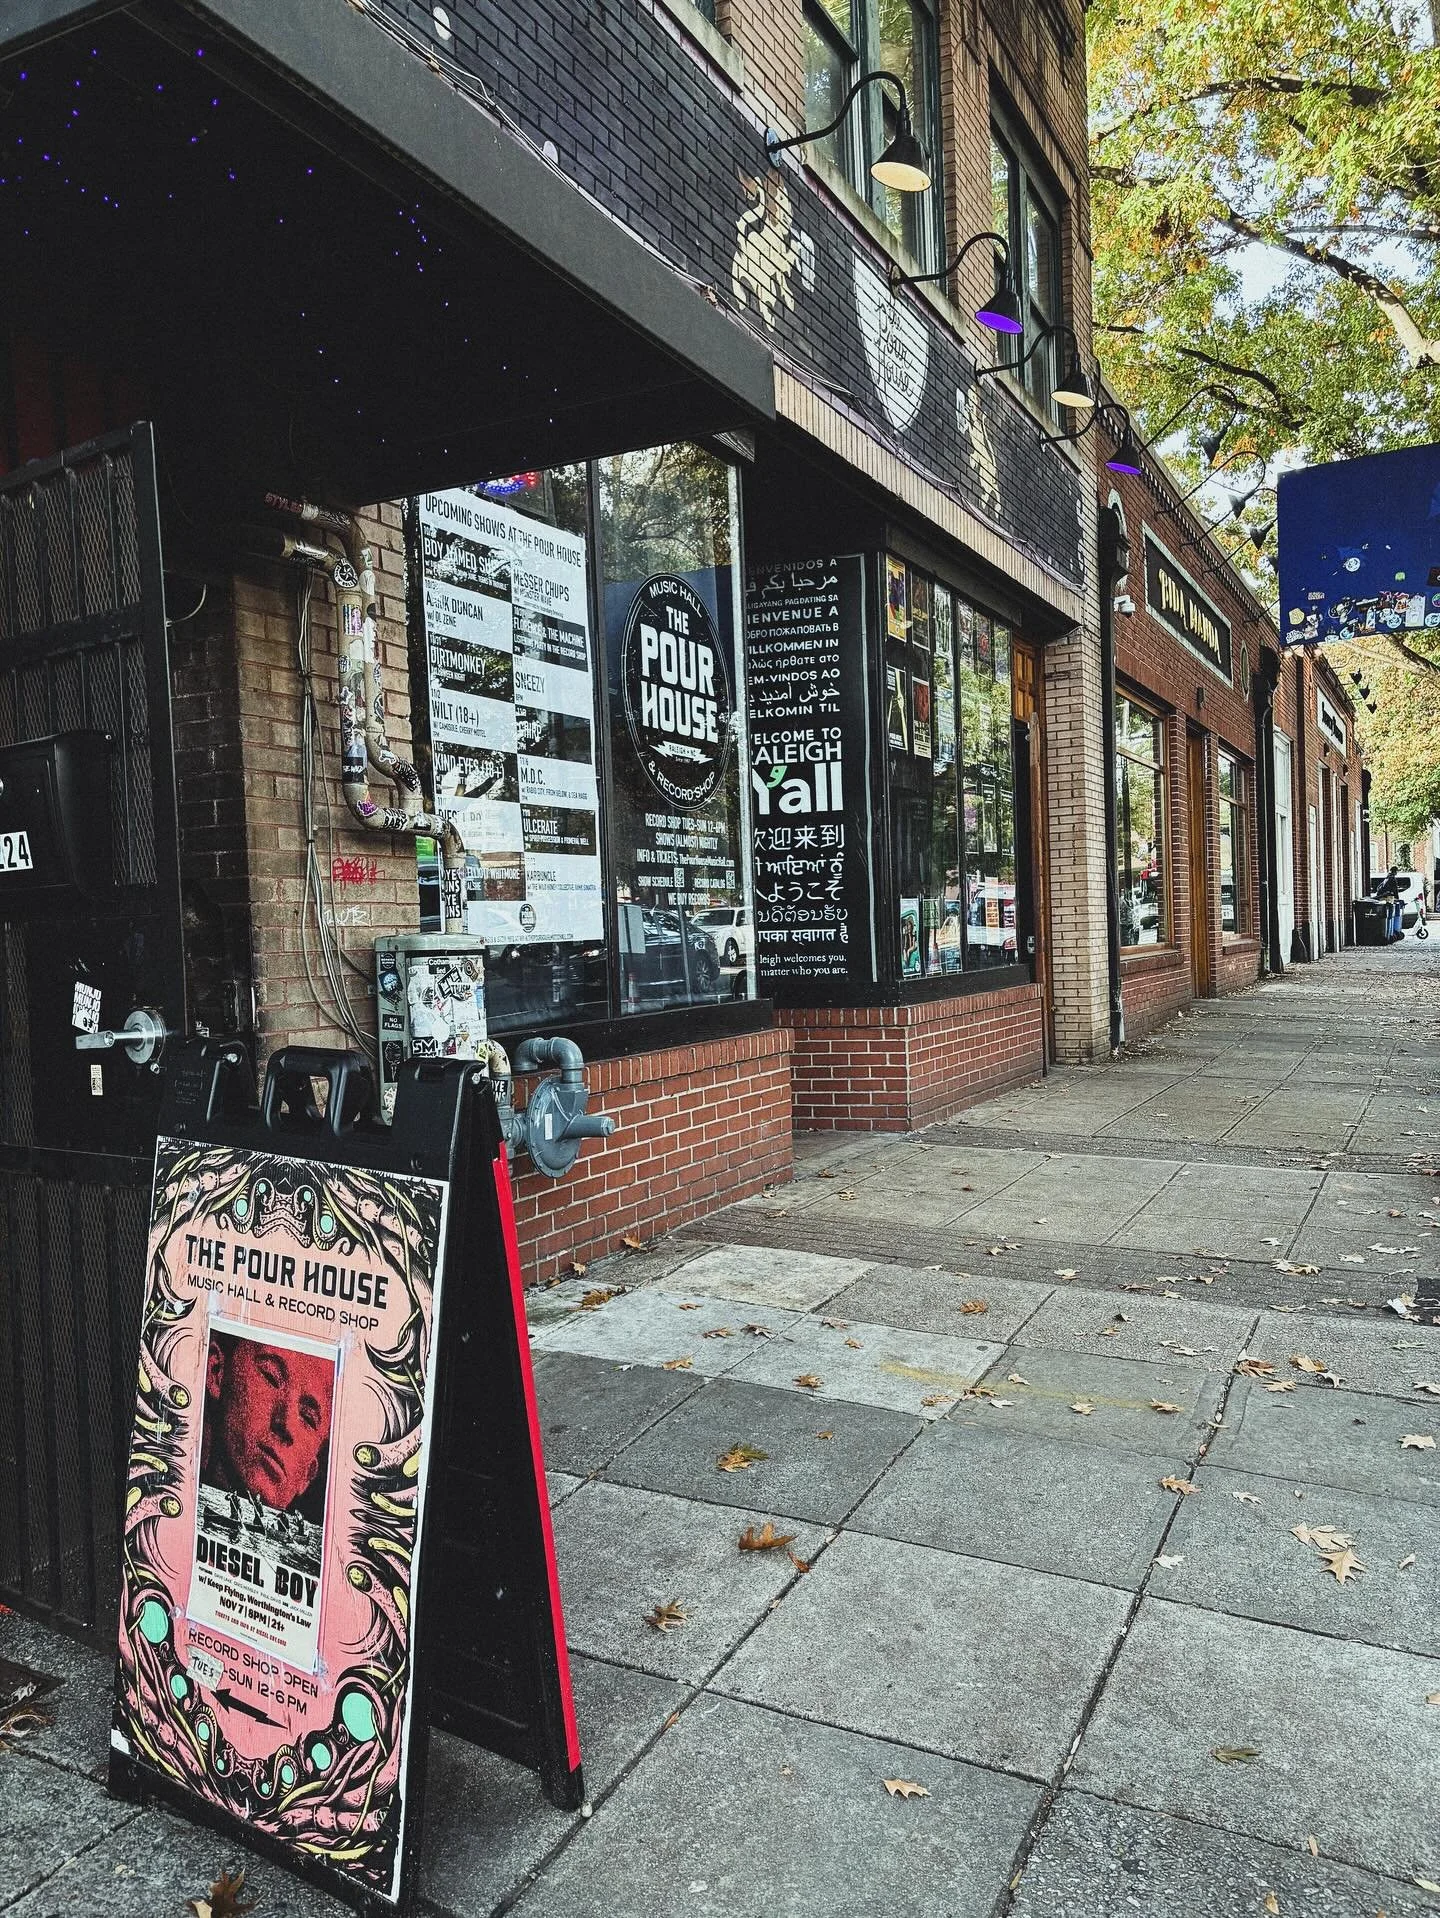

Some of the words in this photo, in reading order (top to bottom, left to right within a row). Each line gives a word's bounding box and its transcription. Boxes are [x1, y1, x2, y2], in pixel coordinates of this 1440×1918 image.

[425, 493, 472, 527] UPCOMING
[474, 513, 506, 539] SHOWS
[508, 526, 517, 542] AT
[518, 530, 532, 548] THE
[534, 536, 555, 559] POUR
[556, 544, 582, 568] HOUSE
[425, 538, 444, 560] BOY
[830, 558, 838, 567] A
[545, 579, 570, 602] CHUPS
[649, 581, 678, 599] MUSIC
[679, 588, 702, 618] HALL
[746, 600, 783, 609] LIGAYANG
[784, 595, 826, 606] PAGDATING
[828, 594, 838, 602] SA
[451, 598, 484, 621] DUNCAN
[666, 605, 690, 636] THE
[747, 607, 822, 625] IENVENUE
[828, 605, 839, 617] A
[747, 629, 767, 640] ОБРО
[747, 640, 822, 655] ILLKOMMEN
[825, 638, 839, 648] IN
[430, 645, 486, 676] DIRTMONKEY
[640, 622, 715, 697] POUR
[515, 671, 545, 693] SNEEZY
[748, 670, 817, 686] EM-VINDOS
[821, 668, 840, 679] AO
[432, 700, 453, 721] WILT
[456, 705, 479, 727] (18+)
[640, 680, 719, 744] HOUSE
[749, 705, 813, 719] ELKOMIN
[819, 703, 840, 712] TIL
[750, 729, 814, 745] ELCOME
[821, 727, 841, 740] TO
[751, 740, 841, 766] ALEIGH
[520, 767, 546, 785] M.D.C.
[648, 760, 656, 775] &
[656, 771, 694, 801] RECORD
[694, 771, 715, 799] SHOP
[523, 818, 558, 835] ULCERATE
[645, 813, 666, 828] RECORD
[667, 815, 681, 829] SHOP
[0, 834, 30, 869] 24
[636, 848, 650, 863] INFO
[651, 851, 656, 863] &
[756, 880, 844, 902] ようこそ
[759, 954, 781, 967] leigh
[784, 953, 826, 963] welcomes
[760, 968, 790, 976] matter
[791, 966, 812, 975] who
[813, 967, 830, 977] you
[185, 1233, 226, 1272] THE
[232, 1245, 296, 1288] POUR
[304, 1260, 389, 1310] HOUSE
[187, 1273, 224, 1294] MUSIC
[227, 1283, 261, 1304] HALL
[265, 1294, 275, 1308] &
[278, 1296, 336, 1322] RECORD
[339, 1310, 379, 1332] SHOP
[196, 1534, 265, 1588] DIESEL
[274, 1565, 319, 1609] BOY
[198, 1574, 206, 1584] w/
[207, 1576, 224, 1592] Keep
[224, 1584, 246, 1602] Flying,
[247, 1594, 296, 1622] Worthington's
[296, 1615, 312, 1629] Law
[219, 1596, 238, 1612] NOV
[239, 1604, 244, 1615] 7
[248, 1609, 267, 1625] 8PM
[270, 1618, 285, 1633] 21+
[188, 1627, 239, 1661] RECORD
[242, 1653, 279, 1676] SHOP
[283, 1671, 319, 1698] OPEN
[191, 1656, 215, 1678] TUES
[257, 1680, 285, 1704] 12-6
[287, 1695, 308, 1716] PM
